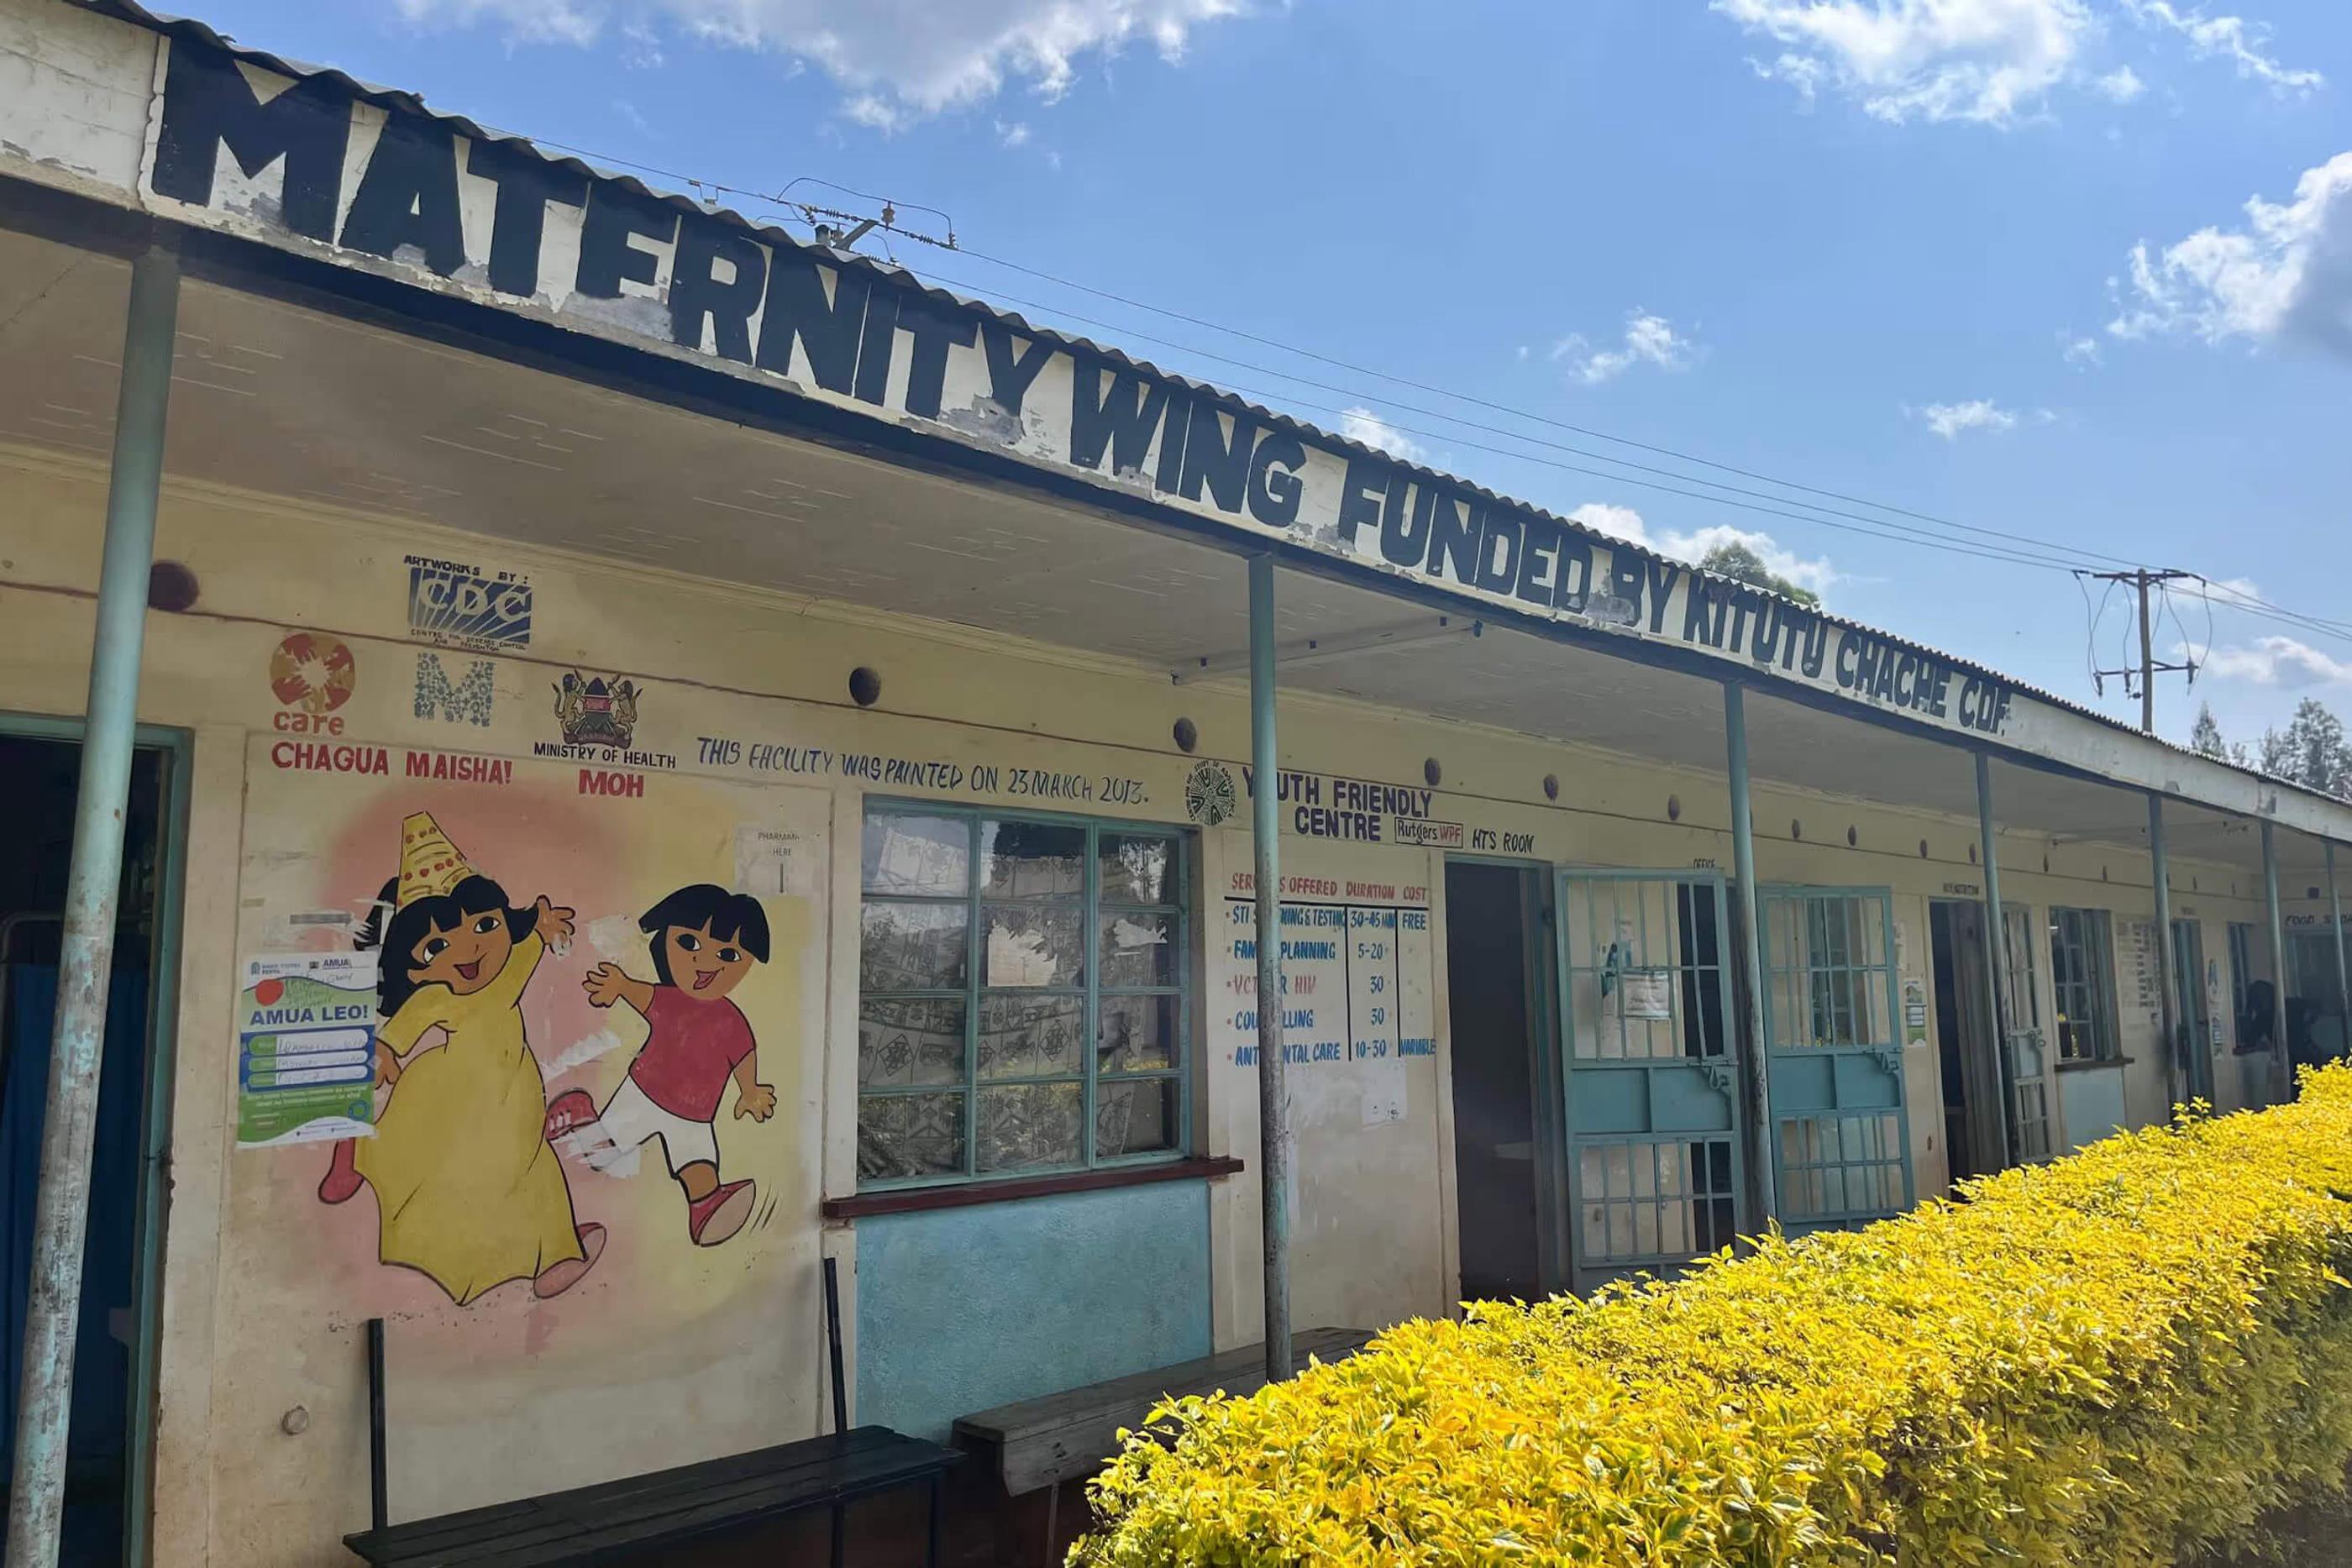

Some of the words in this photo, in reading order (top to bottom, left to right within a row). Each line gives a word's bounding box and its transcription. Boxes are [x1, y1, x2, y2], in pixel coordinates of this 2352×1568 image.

[152, 35, 1058, 441] MATERNITY
[1070, 349, 1307, 527] WING
[1339, 458, 1593, 614] FUNDED
[1610, 544, 1679, 634] BY
[1683, 573, 1830, 679] KITUTU
[1836, 631, 1949, 718] CHACHE
[403, 555, 480, 576] ARTWORKS
[420, 578, 531, 623] CDC
[273, 711, 344, 736] care
[271, 742, 389, 775] CHAGUA
[406, 751, 512, 784] MAISHA!
[534, 742, 596, 760] MINISTRY
[602, 748, 618, 763] OF
[624, 752, 676, 769] HEALTH
[697, 737, 741, 765] THIS
[748, 742, 834, 774] FACILITY
[841, 753, 881, 780] WAS
[885, 758, 963, 790] PAINTED
[970, 764, 1000, 794] ON
[579, 769, 644, 797] MOH
[1242, 766, 1320, 805] YUTH
[1333, 780, 1431, 818] FRIENDLY
[1295, 806, 1381, 842] CENTRE
[1397, 820, 1438, 844] Rutgers
[1438, 824, 1462, 843] WPF
[1232, 873, 1286, 893] SERS
[1289, 877, 1338, 896] OFFERED
[1346, 881, 1395, 899] DURATION
[1404, 886, 1426, 901] COST
[1232, 905, 1249, 925] STI
[1403, 913, 1426, 931] FREE
[1280, 941, 1336, 960] PLANNING
[1358, 943, 1383, 960] 5-20
[1294, 974, 1316, 994] HIV
[1370, 976, 1384, 994] 30
[250, 1008, 314, 1025] AMUA
[323, 1004, 369, 1020] LEO!
[1371, 1008, 1384, 1025] 30
[1312, 1042, 1341, 1062] CARE
[1355, 1040, 1386, 1059] 10-30
